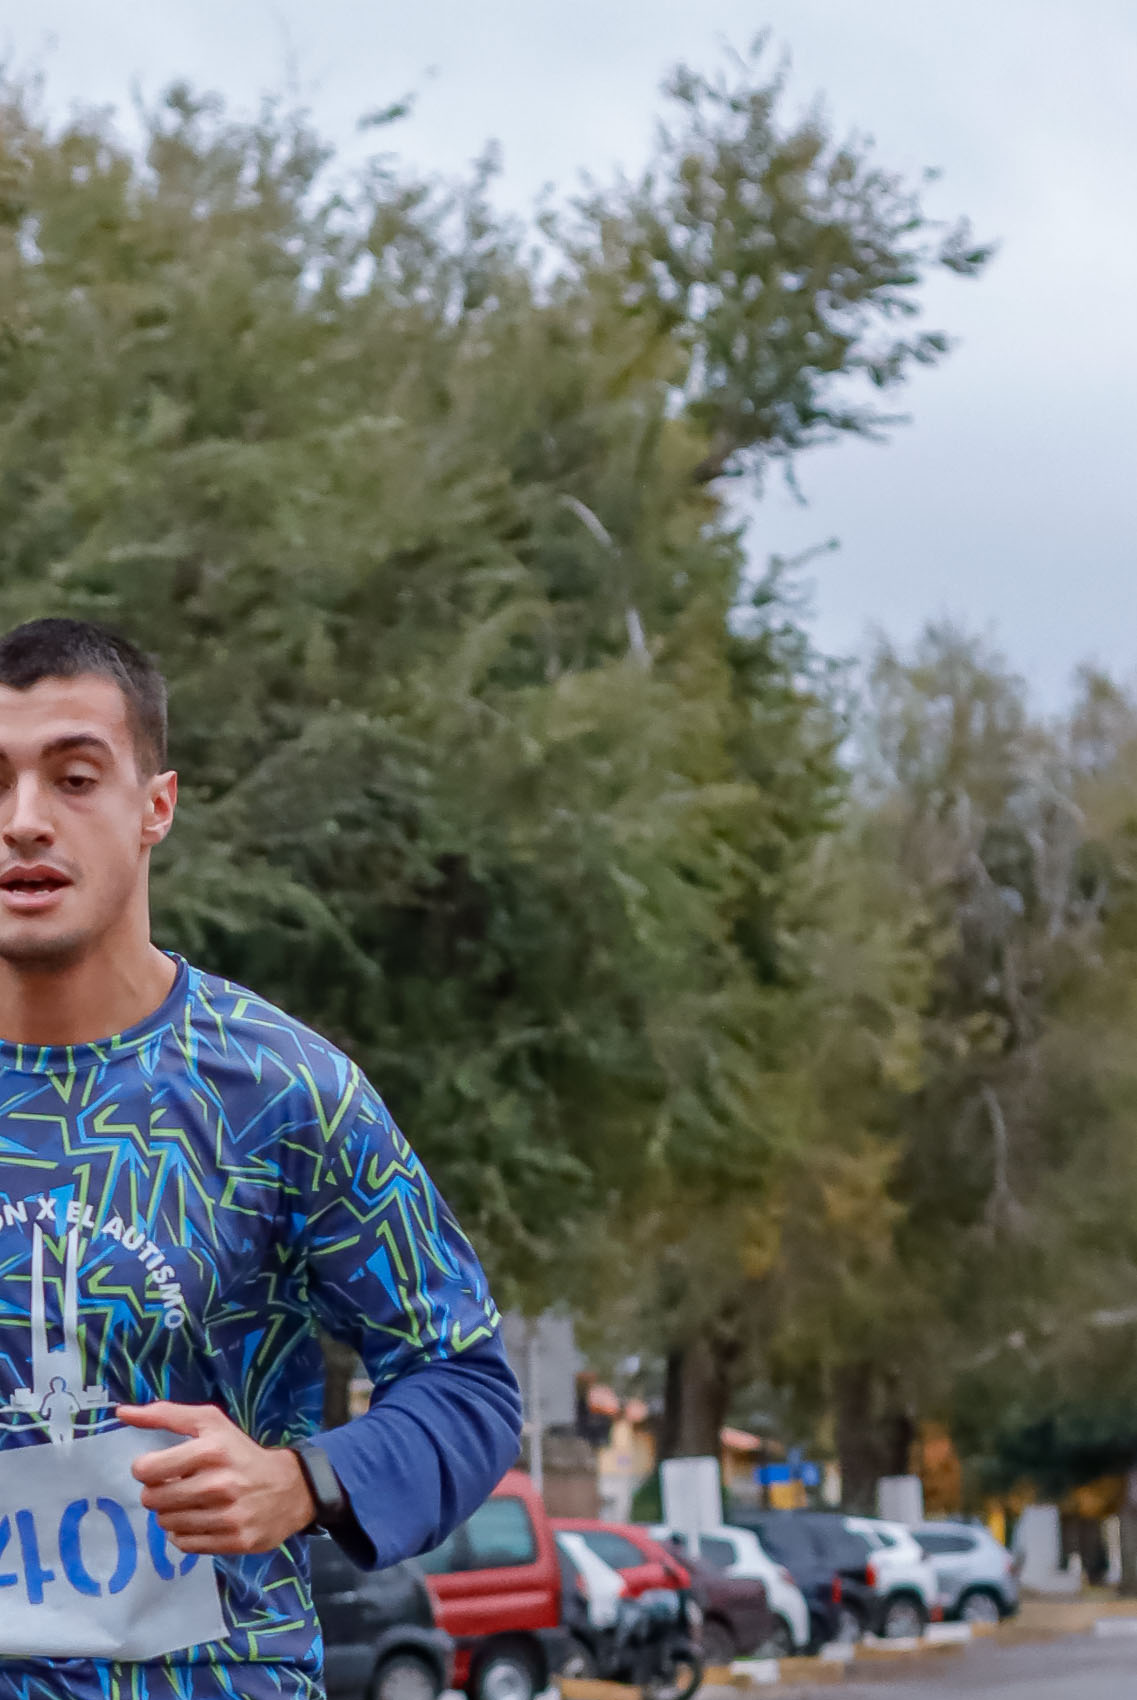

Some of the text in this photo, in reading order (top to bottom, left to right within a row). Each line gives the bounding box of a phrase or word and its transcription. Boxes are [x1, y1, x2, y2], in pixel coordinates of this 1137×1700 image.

[36, 1198, 57, 1220] X
[66, 1200, 95, 1229] EL
[100, 1215, 185, 1330] AUTISMO
